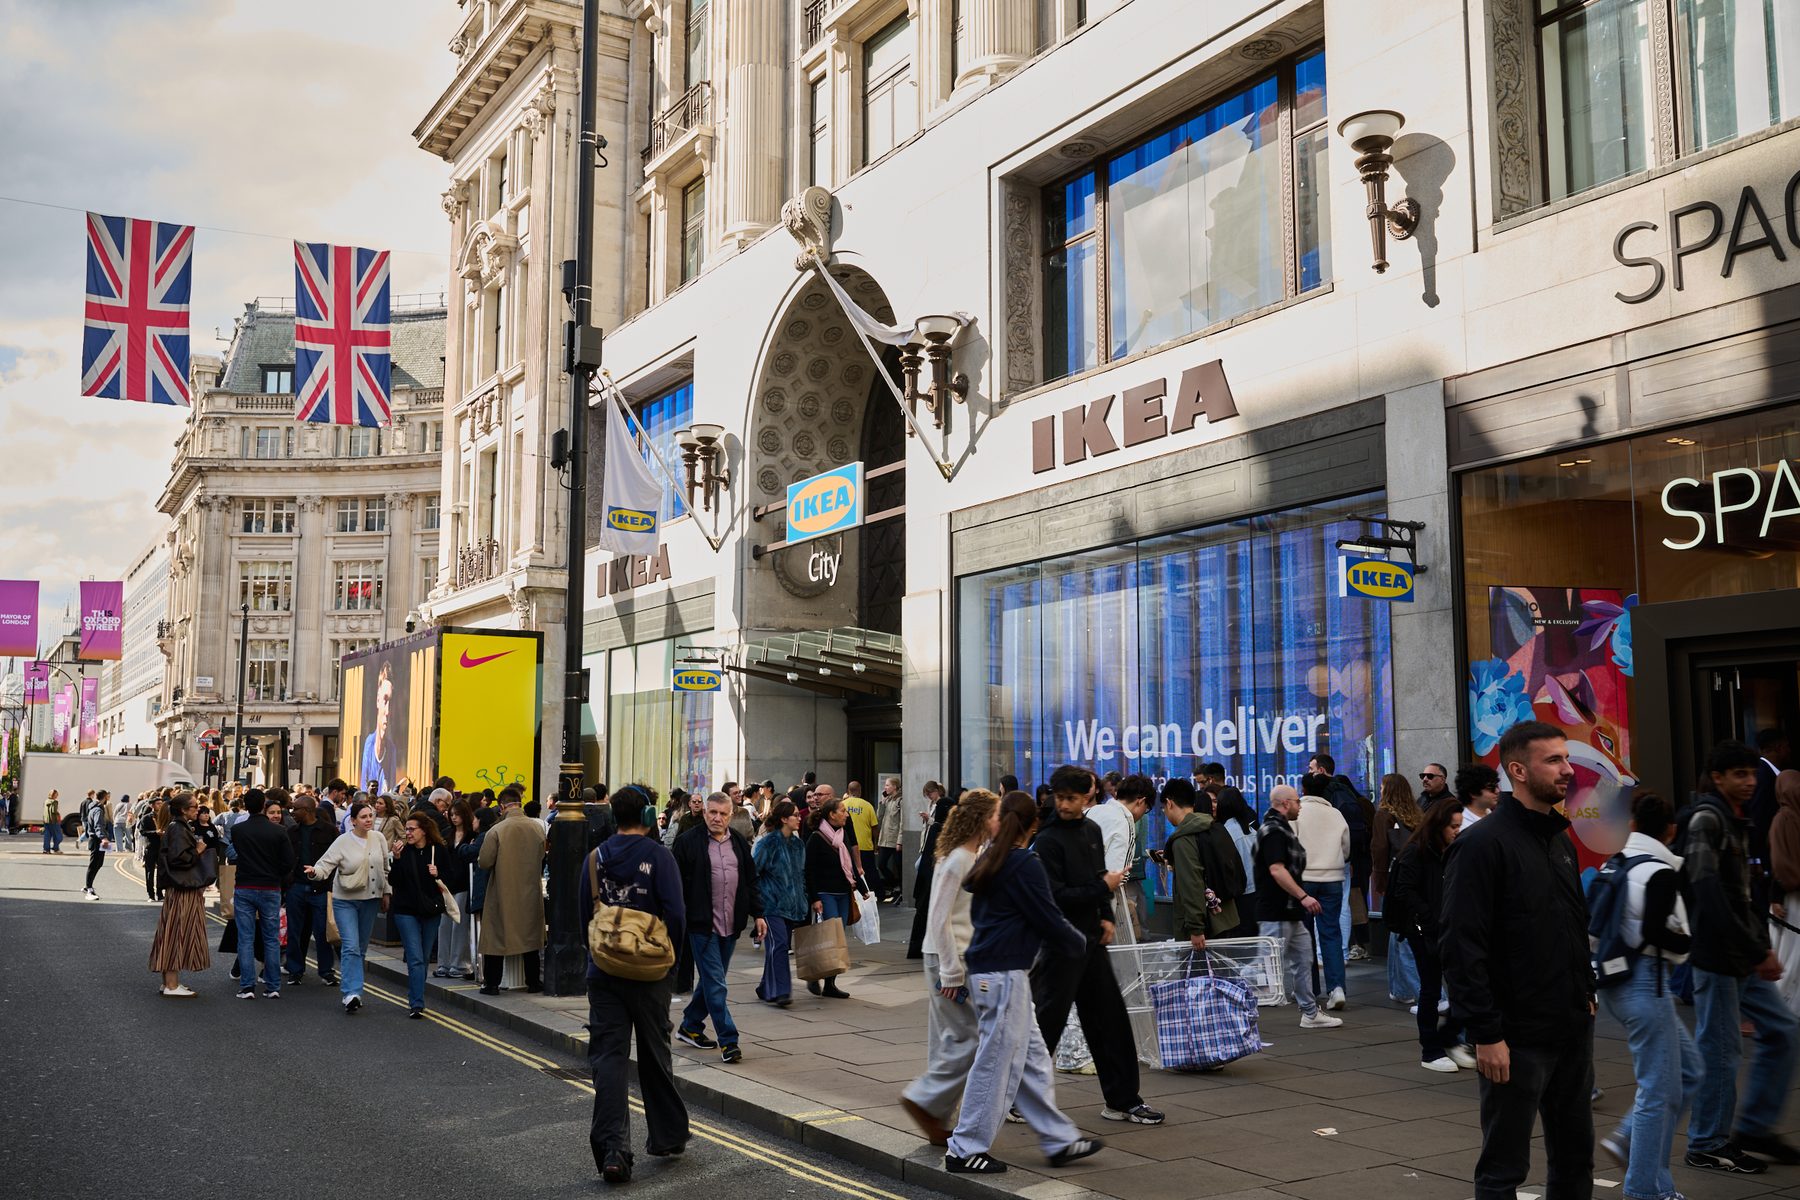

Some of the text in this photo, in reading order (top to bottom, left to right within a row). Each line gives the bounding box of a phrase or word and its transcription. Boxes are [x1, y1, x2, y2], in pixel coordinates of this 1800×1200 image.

[1032, 358, 1240, 475] IKEA
[793, 485, 850, 522] IKEA
[612, 513, 653, 526] IKEA
[597, 543, 672, 598] IKEA
[808, 551, 840, 587] City
[1352, 569, 1408, 589] IKEA
[83, 616, 121, 624] OXFORD
[85, 623, 119, 631] STREET
[677, 676, 717, 684] IKEA
[1065, 706, 1325, 760] We can deliver
[1225, 768, 1256, 793] bus
[848, 806, 862, 815] Hej!
